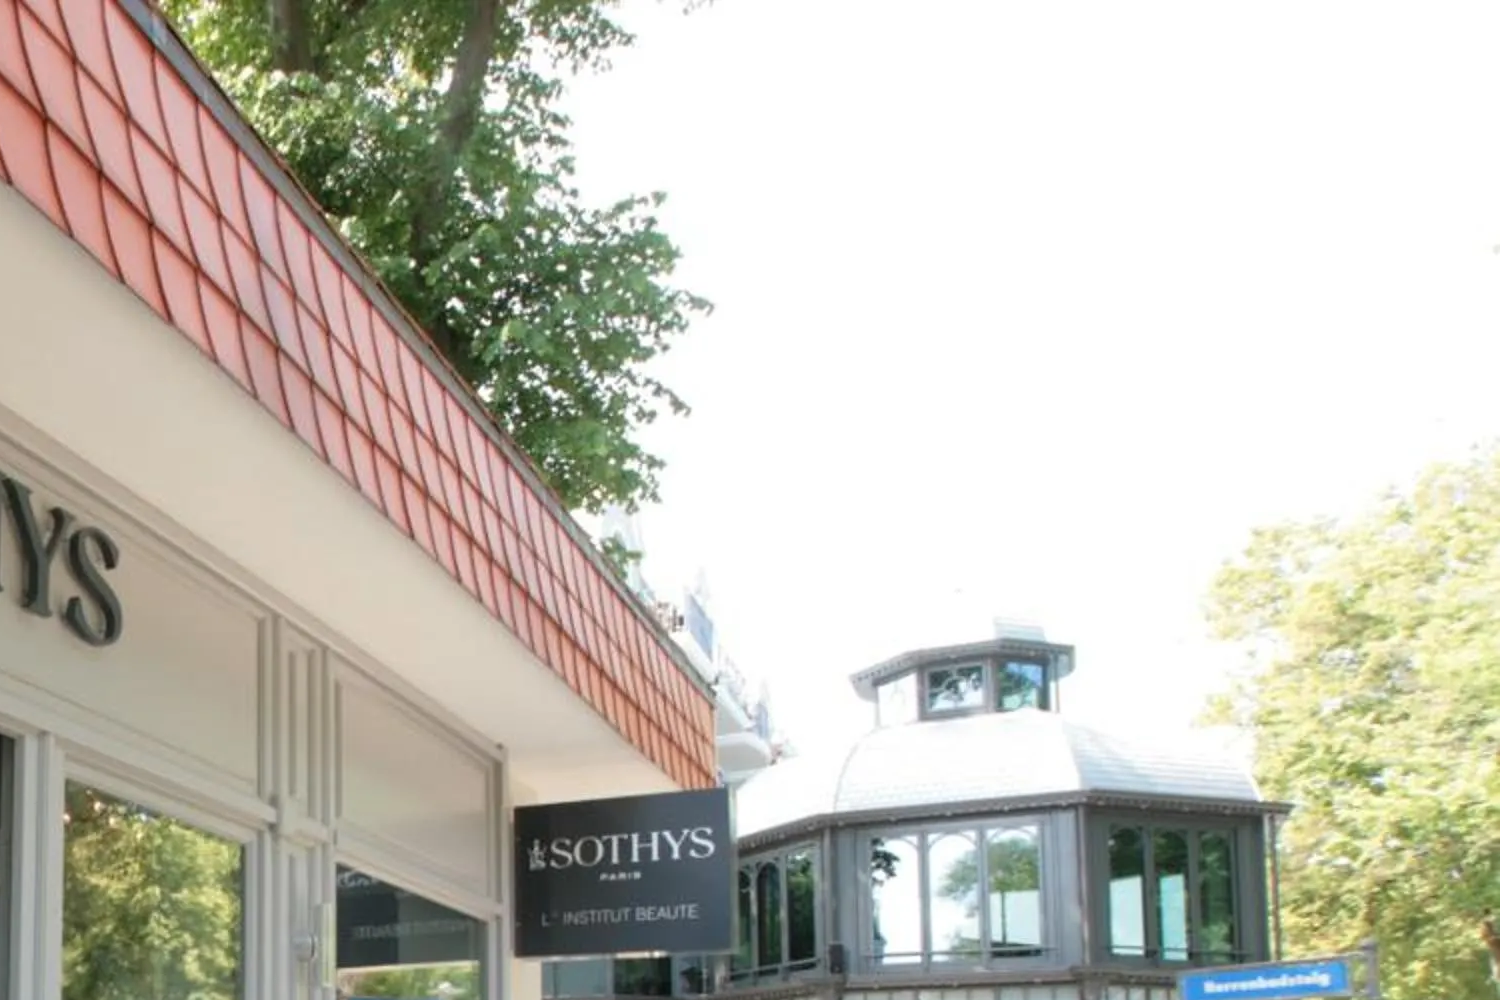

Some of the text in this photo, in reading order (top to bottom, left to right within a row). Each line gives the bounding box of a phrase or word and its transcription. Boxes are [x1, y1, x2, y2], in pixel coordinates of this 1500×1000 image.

[550, 827, 716, 869] SOTHYS
[600, 870, 642, 881] PARIS
[563, 907, 630, 925] INSTITUT
